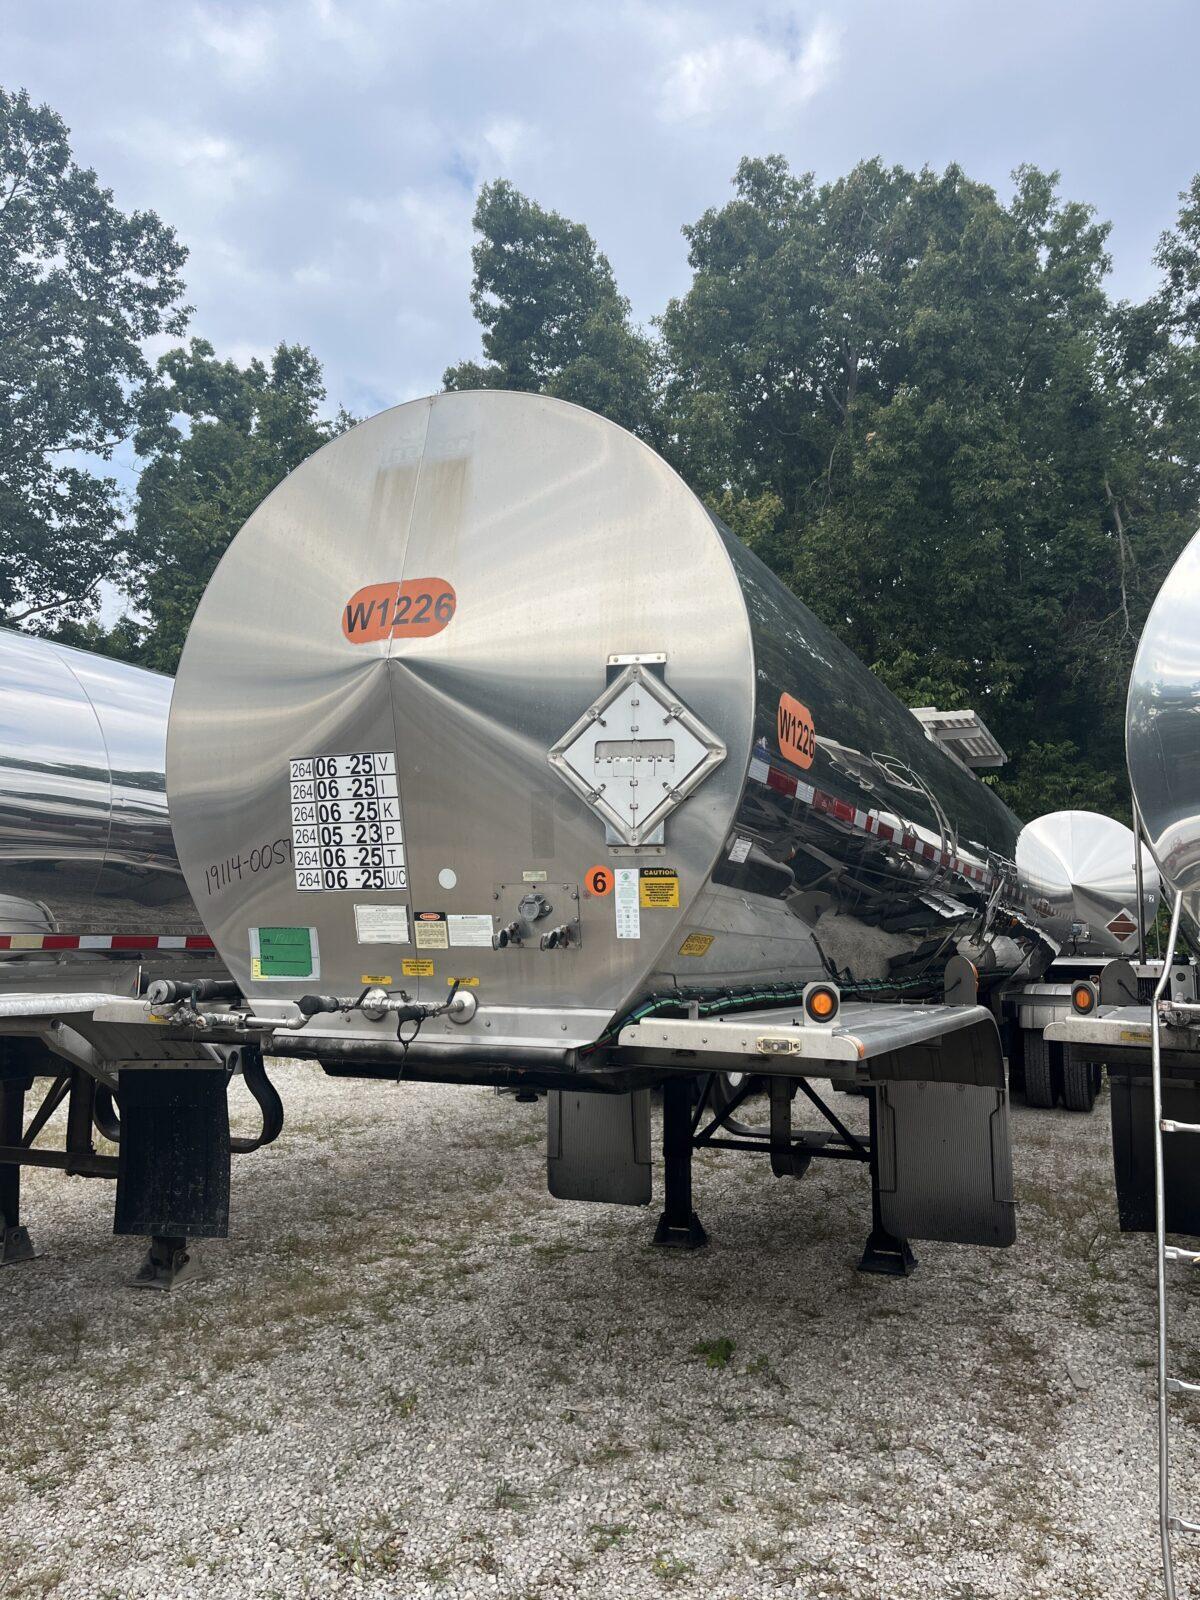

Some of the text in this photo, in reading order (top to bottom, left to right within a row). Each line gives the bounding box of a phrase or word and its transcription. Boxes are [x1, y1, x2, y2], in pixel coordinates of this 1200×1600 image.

[346, 592, 455, 633] W1226
[780, 706, 815, 758] W1226
[292, 763, 312, 778] 264
[378, 756, 388, 771] V
[293, 784, 313, 799] 264
[294, 806, 314, 822] 264
[383, 802, 394, 818] K
[295, 828, 316, 844] 264
[386, 826, 395, 841] P
[297, 851, 318, 866] 264
[387, 849, 396, 865] T
[298, 872, 320, 887] 264
[593, 872, 606, 893] 6
